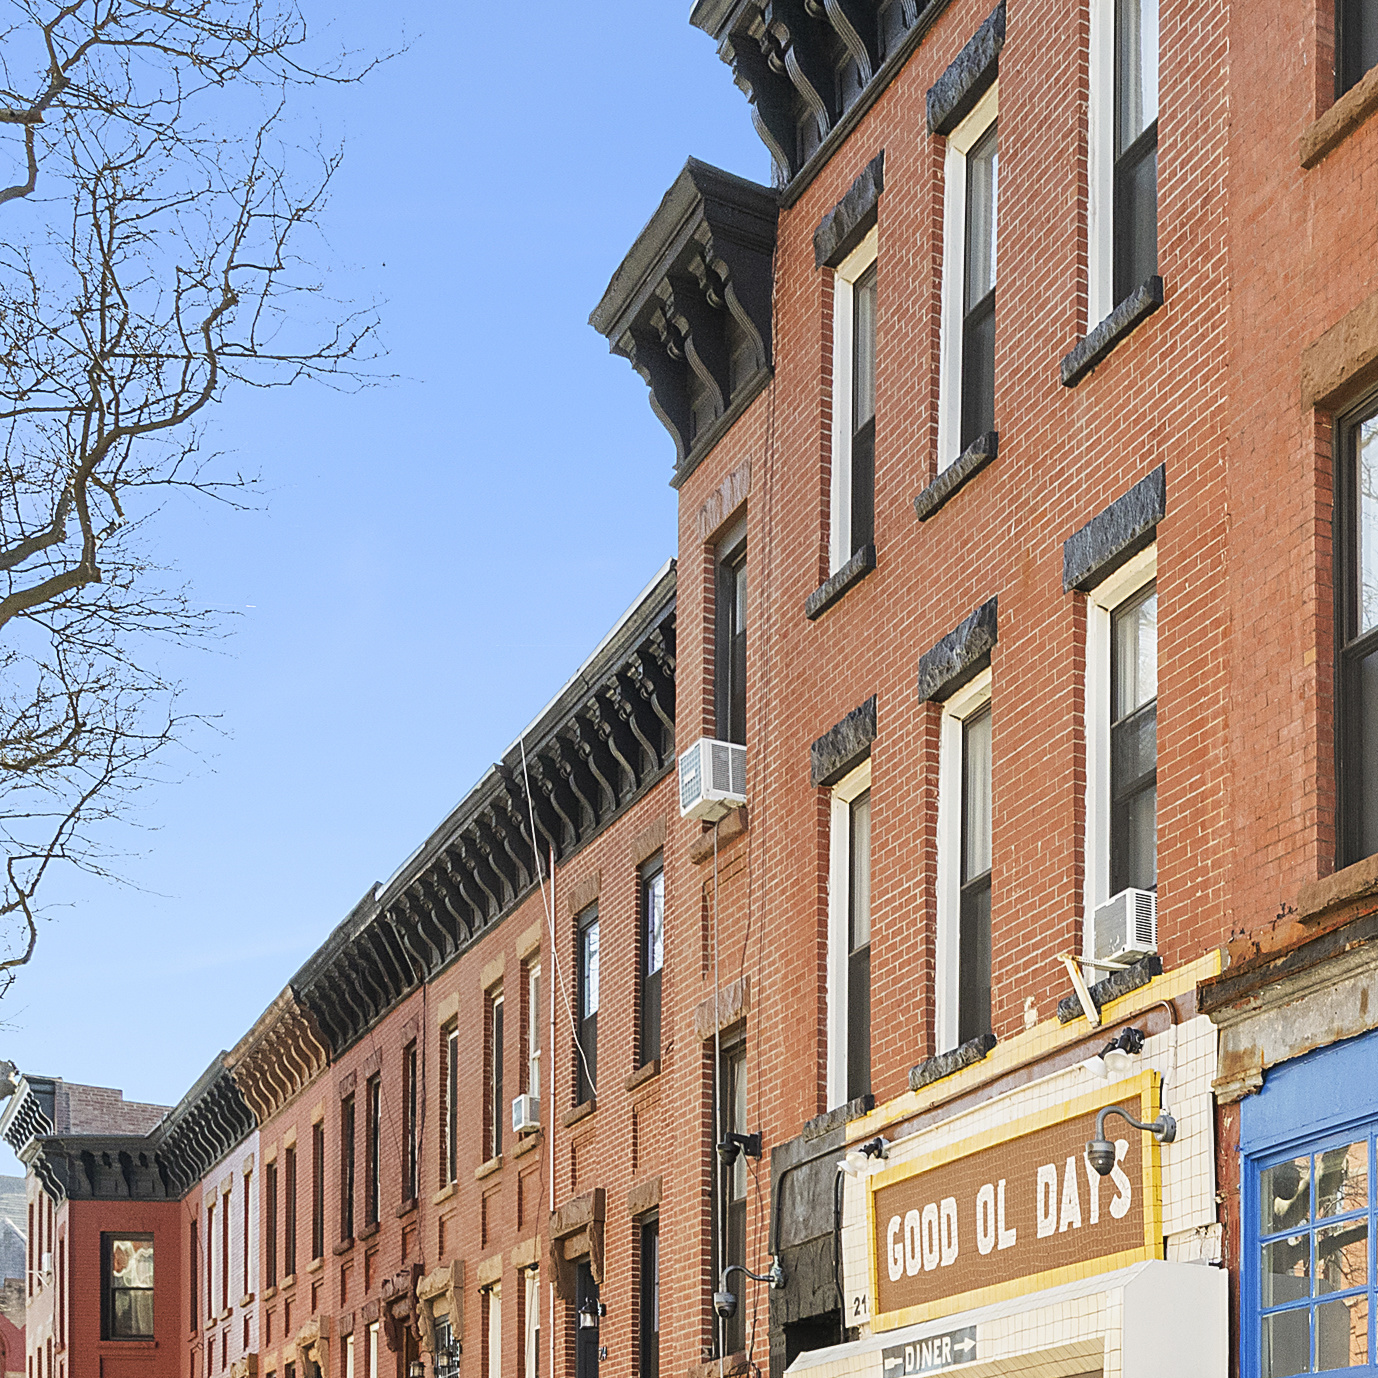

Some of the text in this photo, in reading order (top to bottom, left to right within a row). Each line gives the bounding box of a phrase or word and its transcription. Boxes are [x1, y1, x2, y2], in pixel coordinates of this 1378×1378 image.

[886, 1139, 1133, 1283] GOOD OL DAYS
[904, 1336, 952, 1373] DINER
